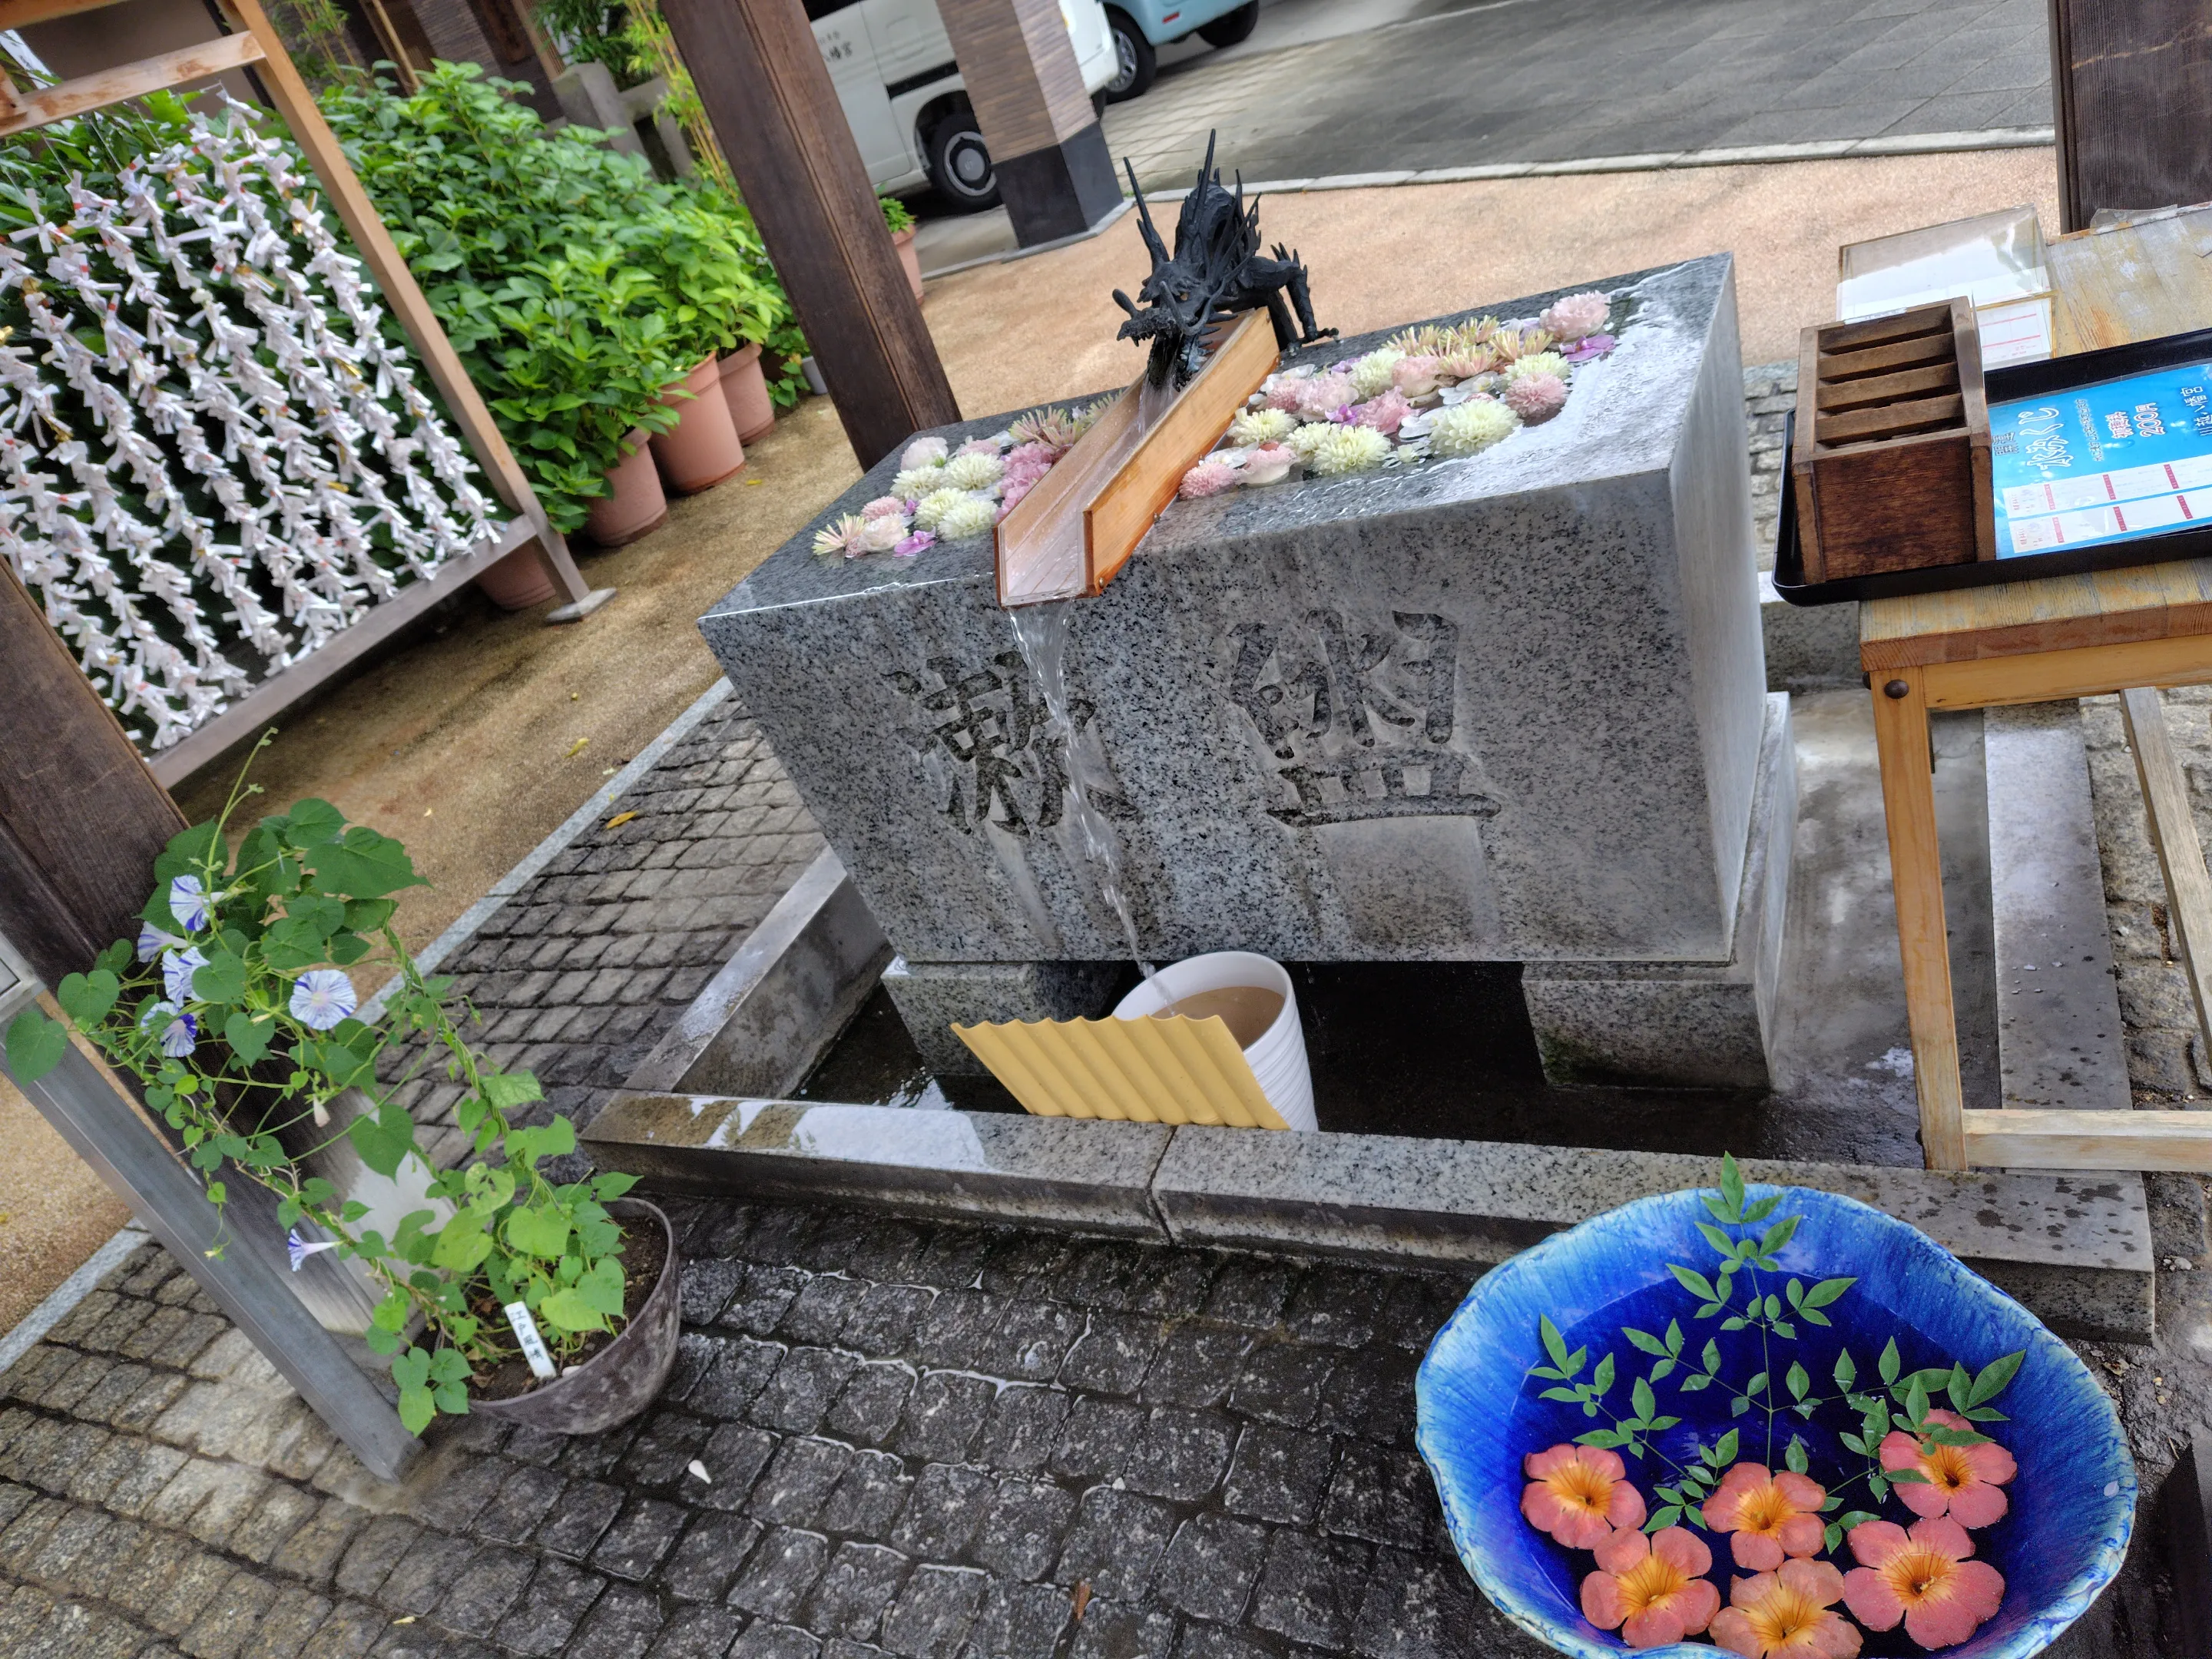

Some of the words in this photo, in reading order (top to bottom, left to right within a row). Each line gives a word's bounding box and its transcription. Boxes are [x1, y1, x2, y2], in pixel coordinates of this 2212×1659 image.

[2105, 411, 2134, 439] 初穂料
[2134, 402, 2166, 438] 200円
[2018, 407, 2074, 471] 水みくじ
